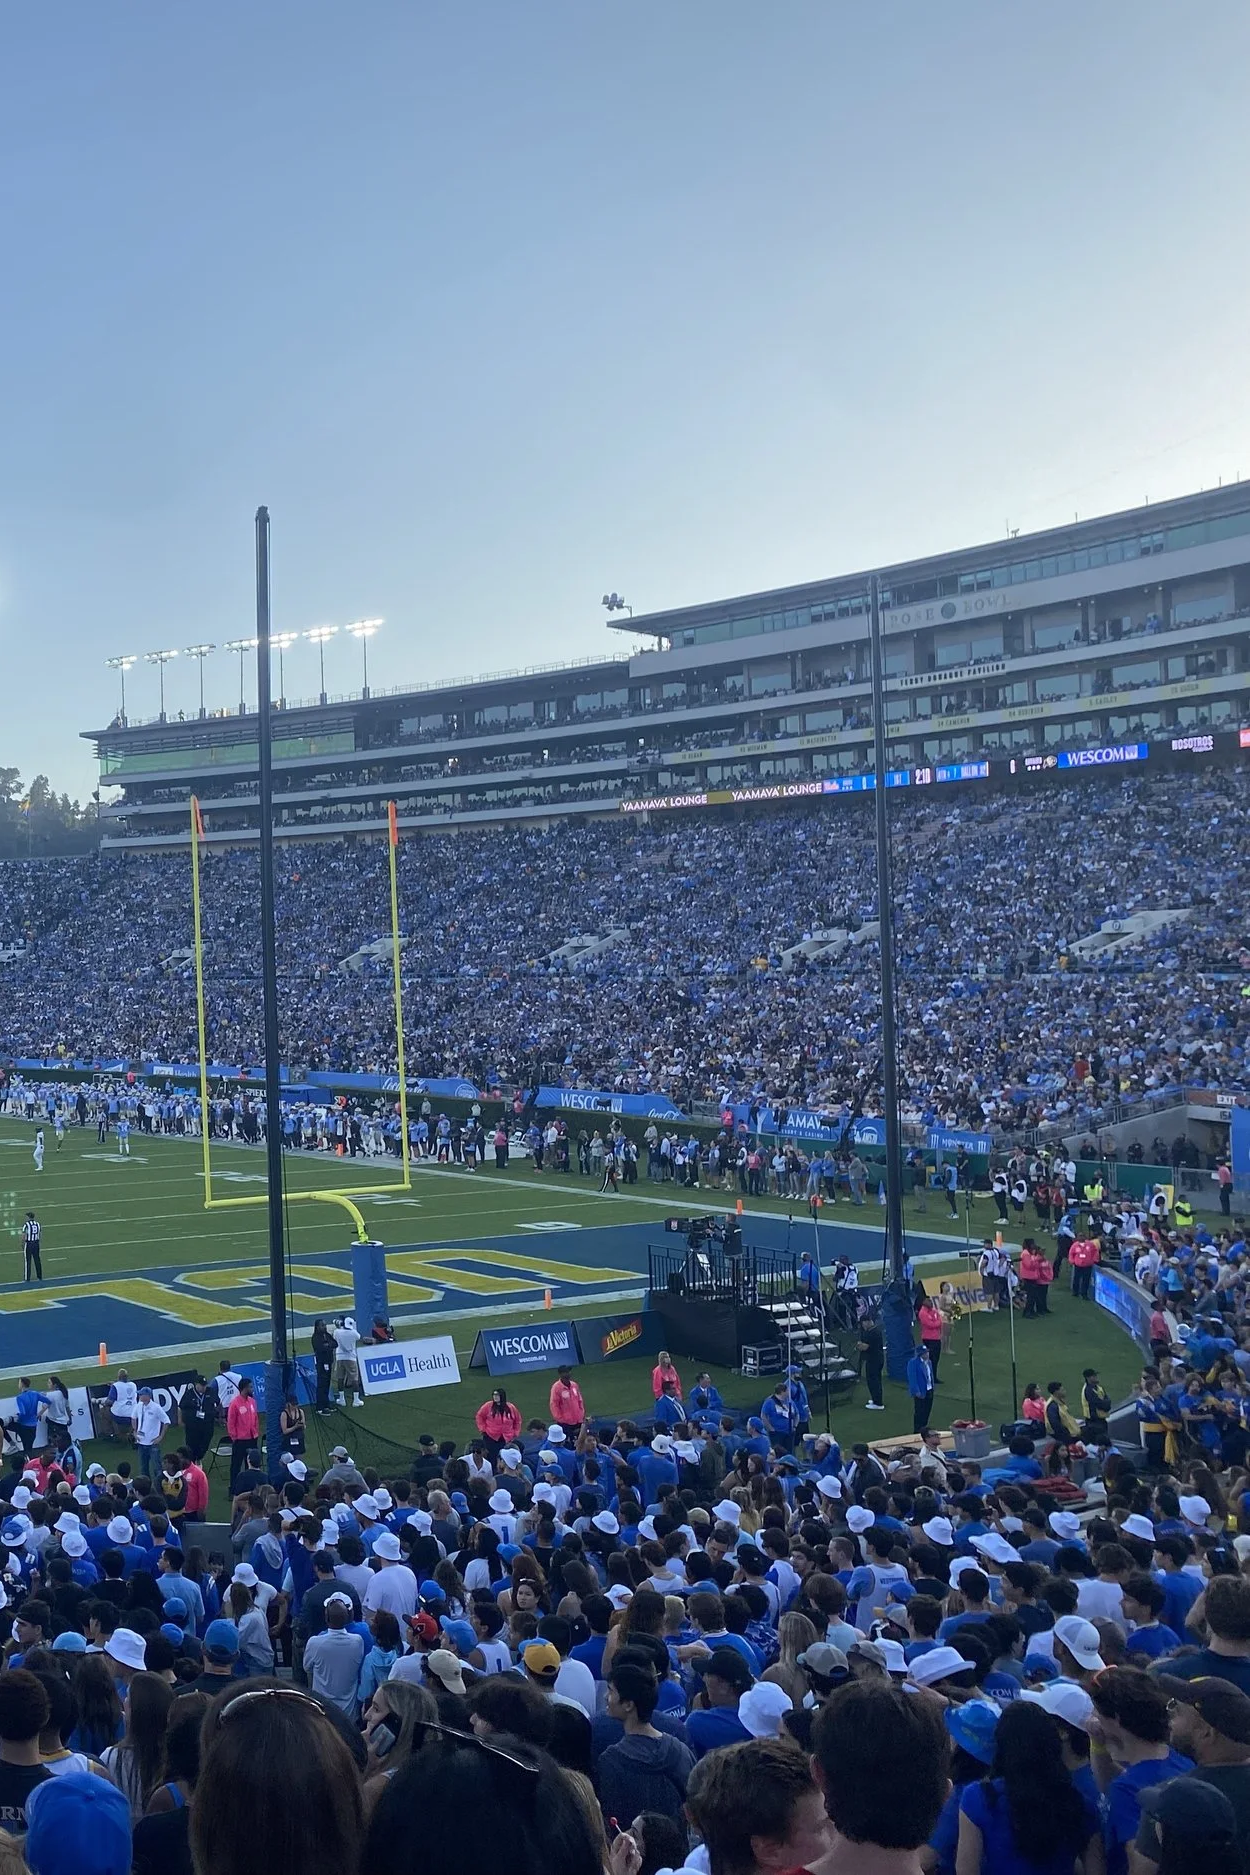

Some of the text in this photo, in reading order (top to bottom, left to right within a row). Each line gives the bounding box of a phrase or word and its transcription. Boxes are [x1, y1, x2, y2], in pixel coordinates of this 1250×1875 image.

[1067, 747, 1125, 766] WESCOM
[731, 782, 822, 801] YAAMAVA' LOUNGE
[622, 794, 708, 812] YAAMAVA' LOUNGE
[490, 1334, 553, 1358] WESCOM
[369, 1353, 452, 1377] UCLA Health
[518, 1354, 547, 1363] wescom.org
